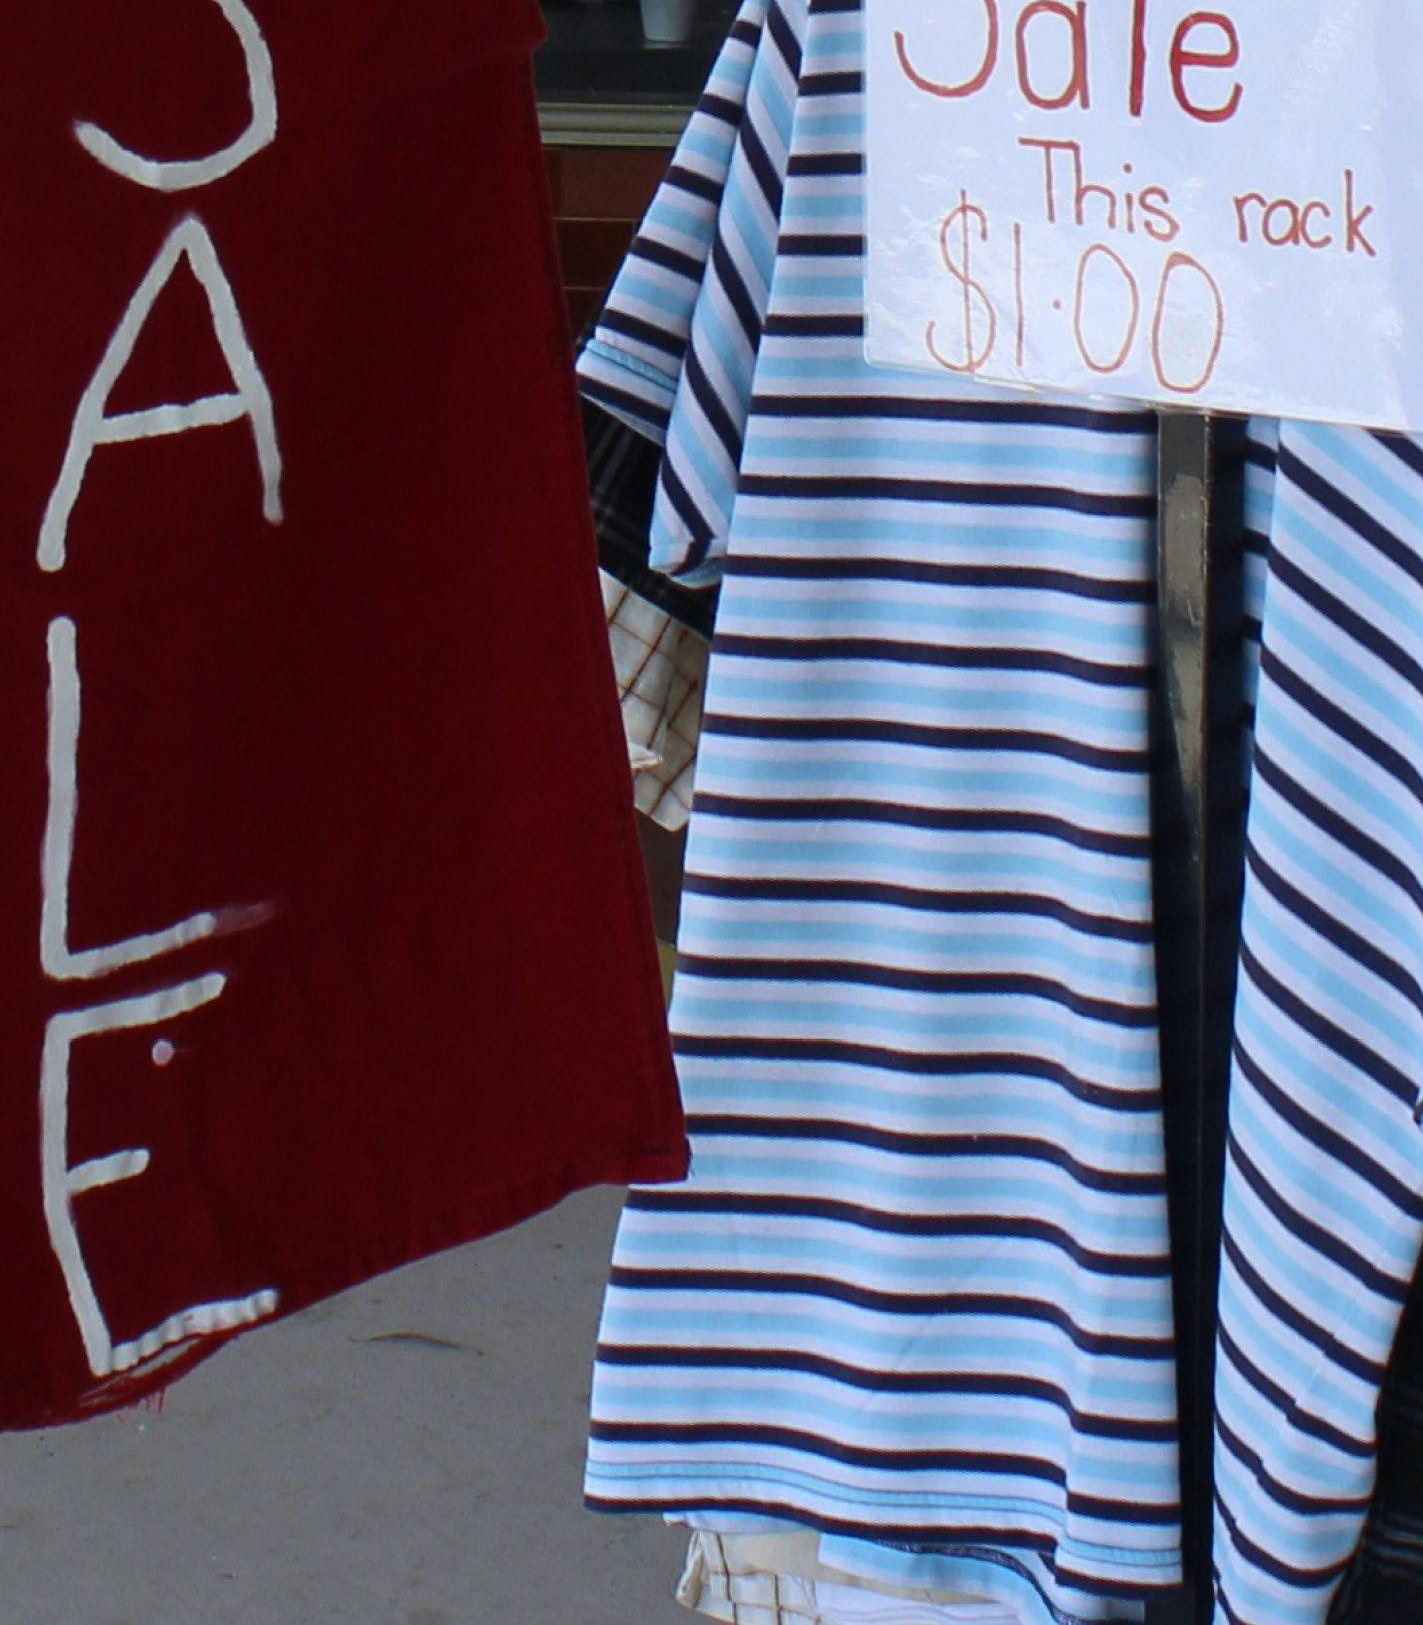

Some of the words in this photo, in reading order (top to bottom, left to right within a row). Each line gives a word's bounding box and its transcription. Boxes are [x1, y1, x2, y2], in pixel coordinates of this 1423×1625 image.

[1017, 135, 1181, 242] This
[1232, 167, 1378, 259] rack
[924, 187, 1225, 394] $1.00
